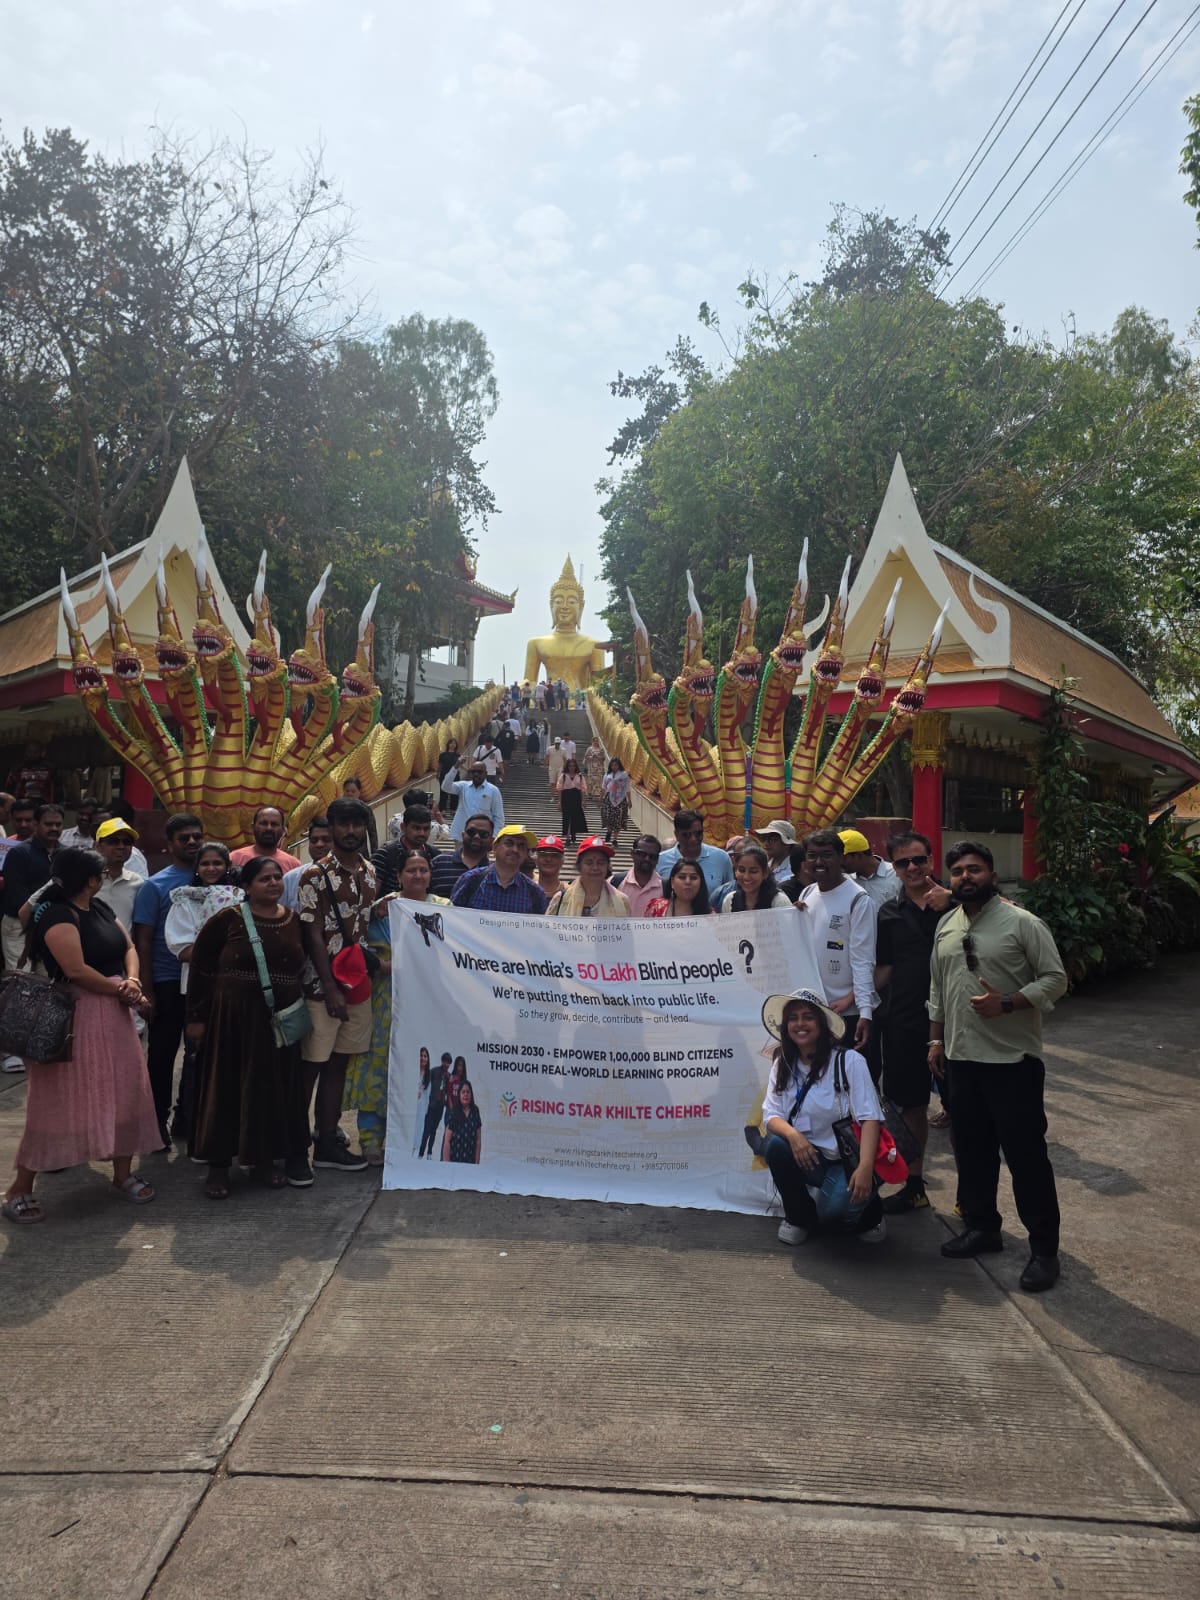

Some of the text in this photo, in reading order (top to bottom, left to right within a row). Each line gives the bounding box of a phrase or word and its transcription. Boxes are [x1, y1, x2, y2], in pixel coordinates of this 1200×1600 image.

[479, 917, 520, 929] Designing
[552, 922, 589, 931] SENSORY
[592, 923, 632, 932] HERITAGE
[634, 922, 651, 930] into
[686, 920, 698, 928] for
[558, 934, 623, 943] BLIND TOURISM
[453, 939, 755, 984] Where are India's 50 Lakh Blind people ?
[492, 985, 720, 1009] We're putting them back into public life.
[518, 1009, 529, 1018] So
[530, 1009, 549, 1021] they
[550, 1012, 571, 1023] grow,
[573, 1012, 600, 1024] decide,
[602, 1014, 643, 1024] contribute
[653, 1013, 669, 1024] and
[477, 1042, 519, 1055] MISSION
[521, 1045, 545, 1057] 2030
[553, 1048, 607, 1061] EMPOWER
[609, 1051, 651, 1064] 1,00,000
[653, 1051, 685, 1062] BLIND
[687, 1048, 734, 1060] CITIZENS
[489, 1060, 719, 1080] THROUGH REAL-WORLD LEARNING PROGRAM
[521, 1099, 711, 1120] RISING STAR KHILTE CHEHRE
